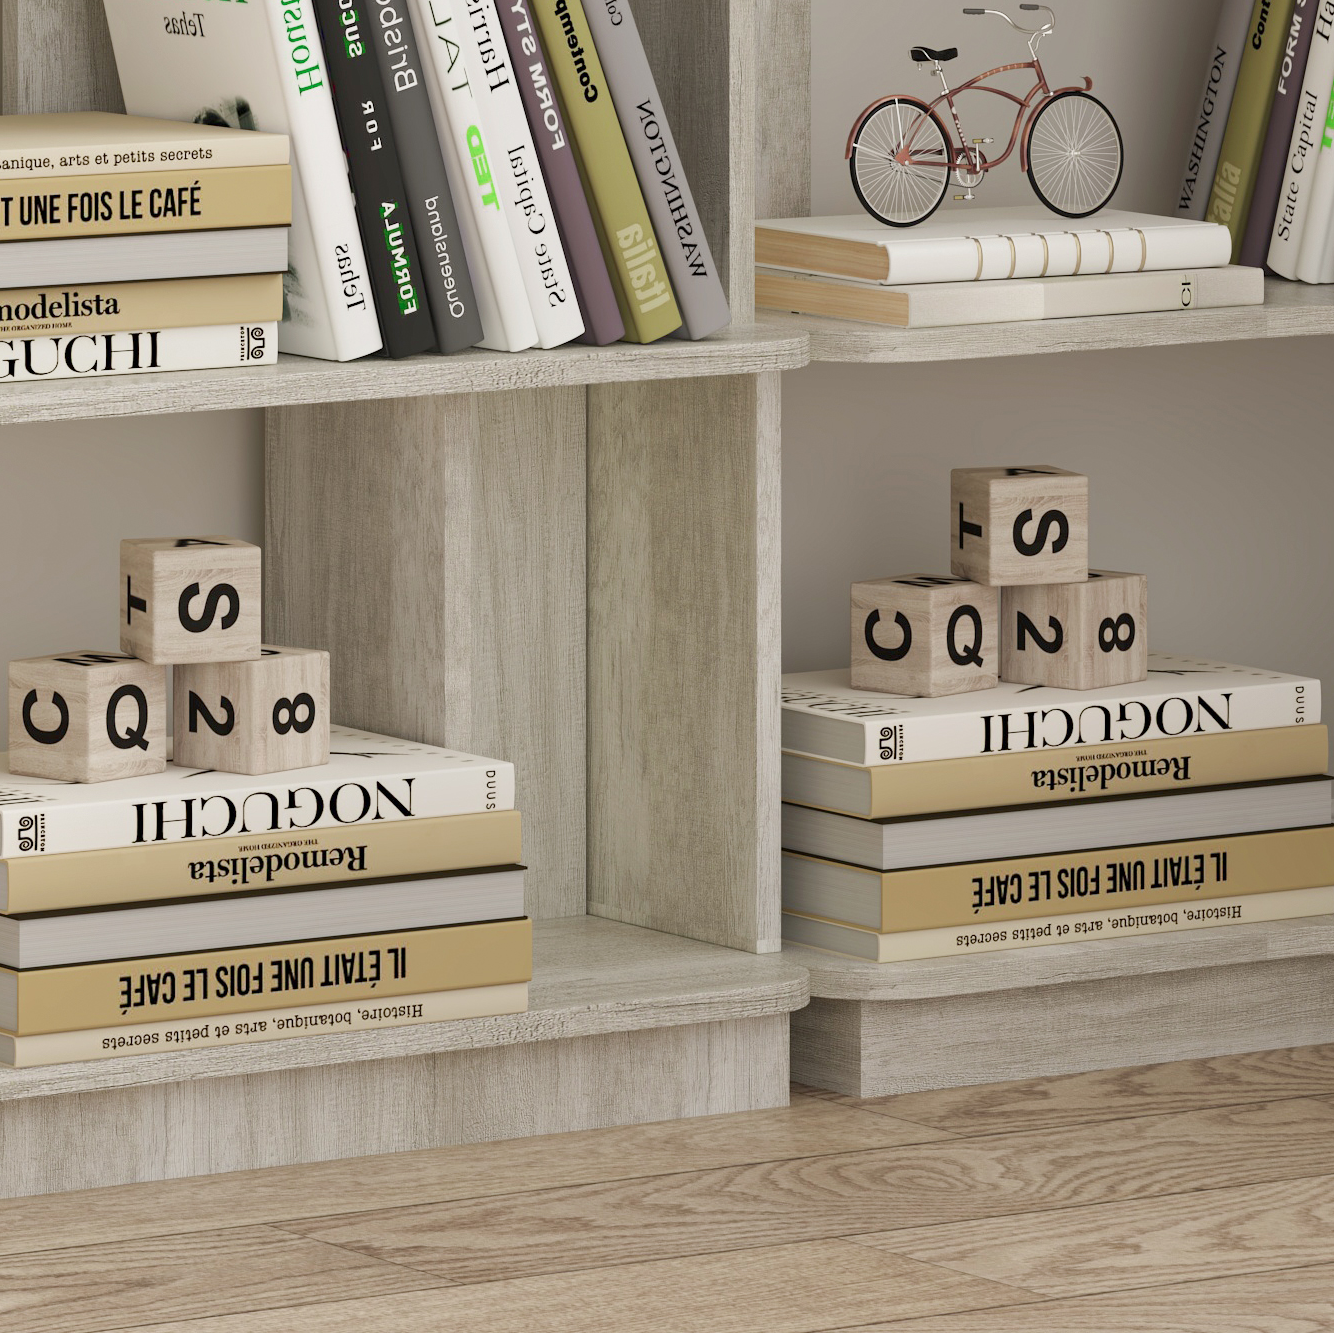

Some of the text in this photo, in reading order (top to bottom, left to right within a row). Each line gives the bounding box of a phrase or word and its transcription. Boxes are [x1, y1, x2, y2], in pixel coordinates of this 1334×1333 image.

[1277, 13, 1302, 95] FORM
[1178, 46, 1226, 212] WASHINGTON
[1276, 92, 1318, 242] State Capital
[20, 194, 61, 225] UNE
[68, 192, 112, 223] FOIS
[119, 189, 143, 220] LE
[149, 181, 201, 218] CAFÉ
[177, 582, 240, 633] S
[22, 689, 70, 745] C
[105, 684, 149, 752] Q
[188, 691, 235, 737] 2
[272, 692, 316, 735] 8
[132, 778, 416, 844] NOGUCHI
[187, 845, 368, 885] Remodelista
